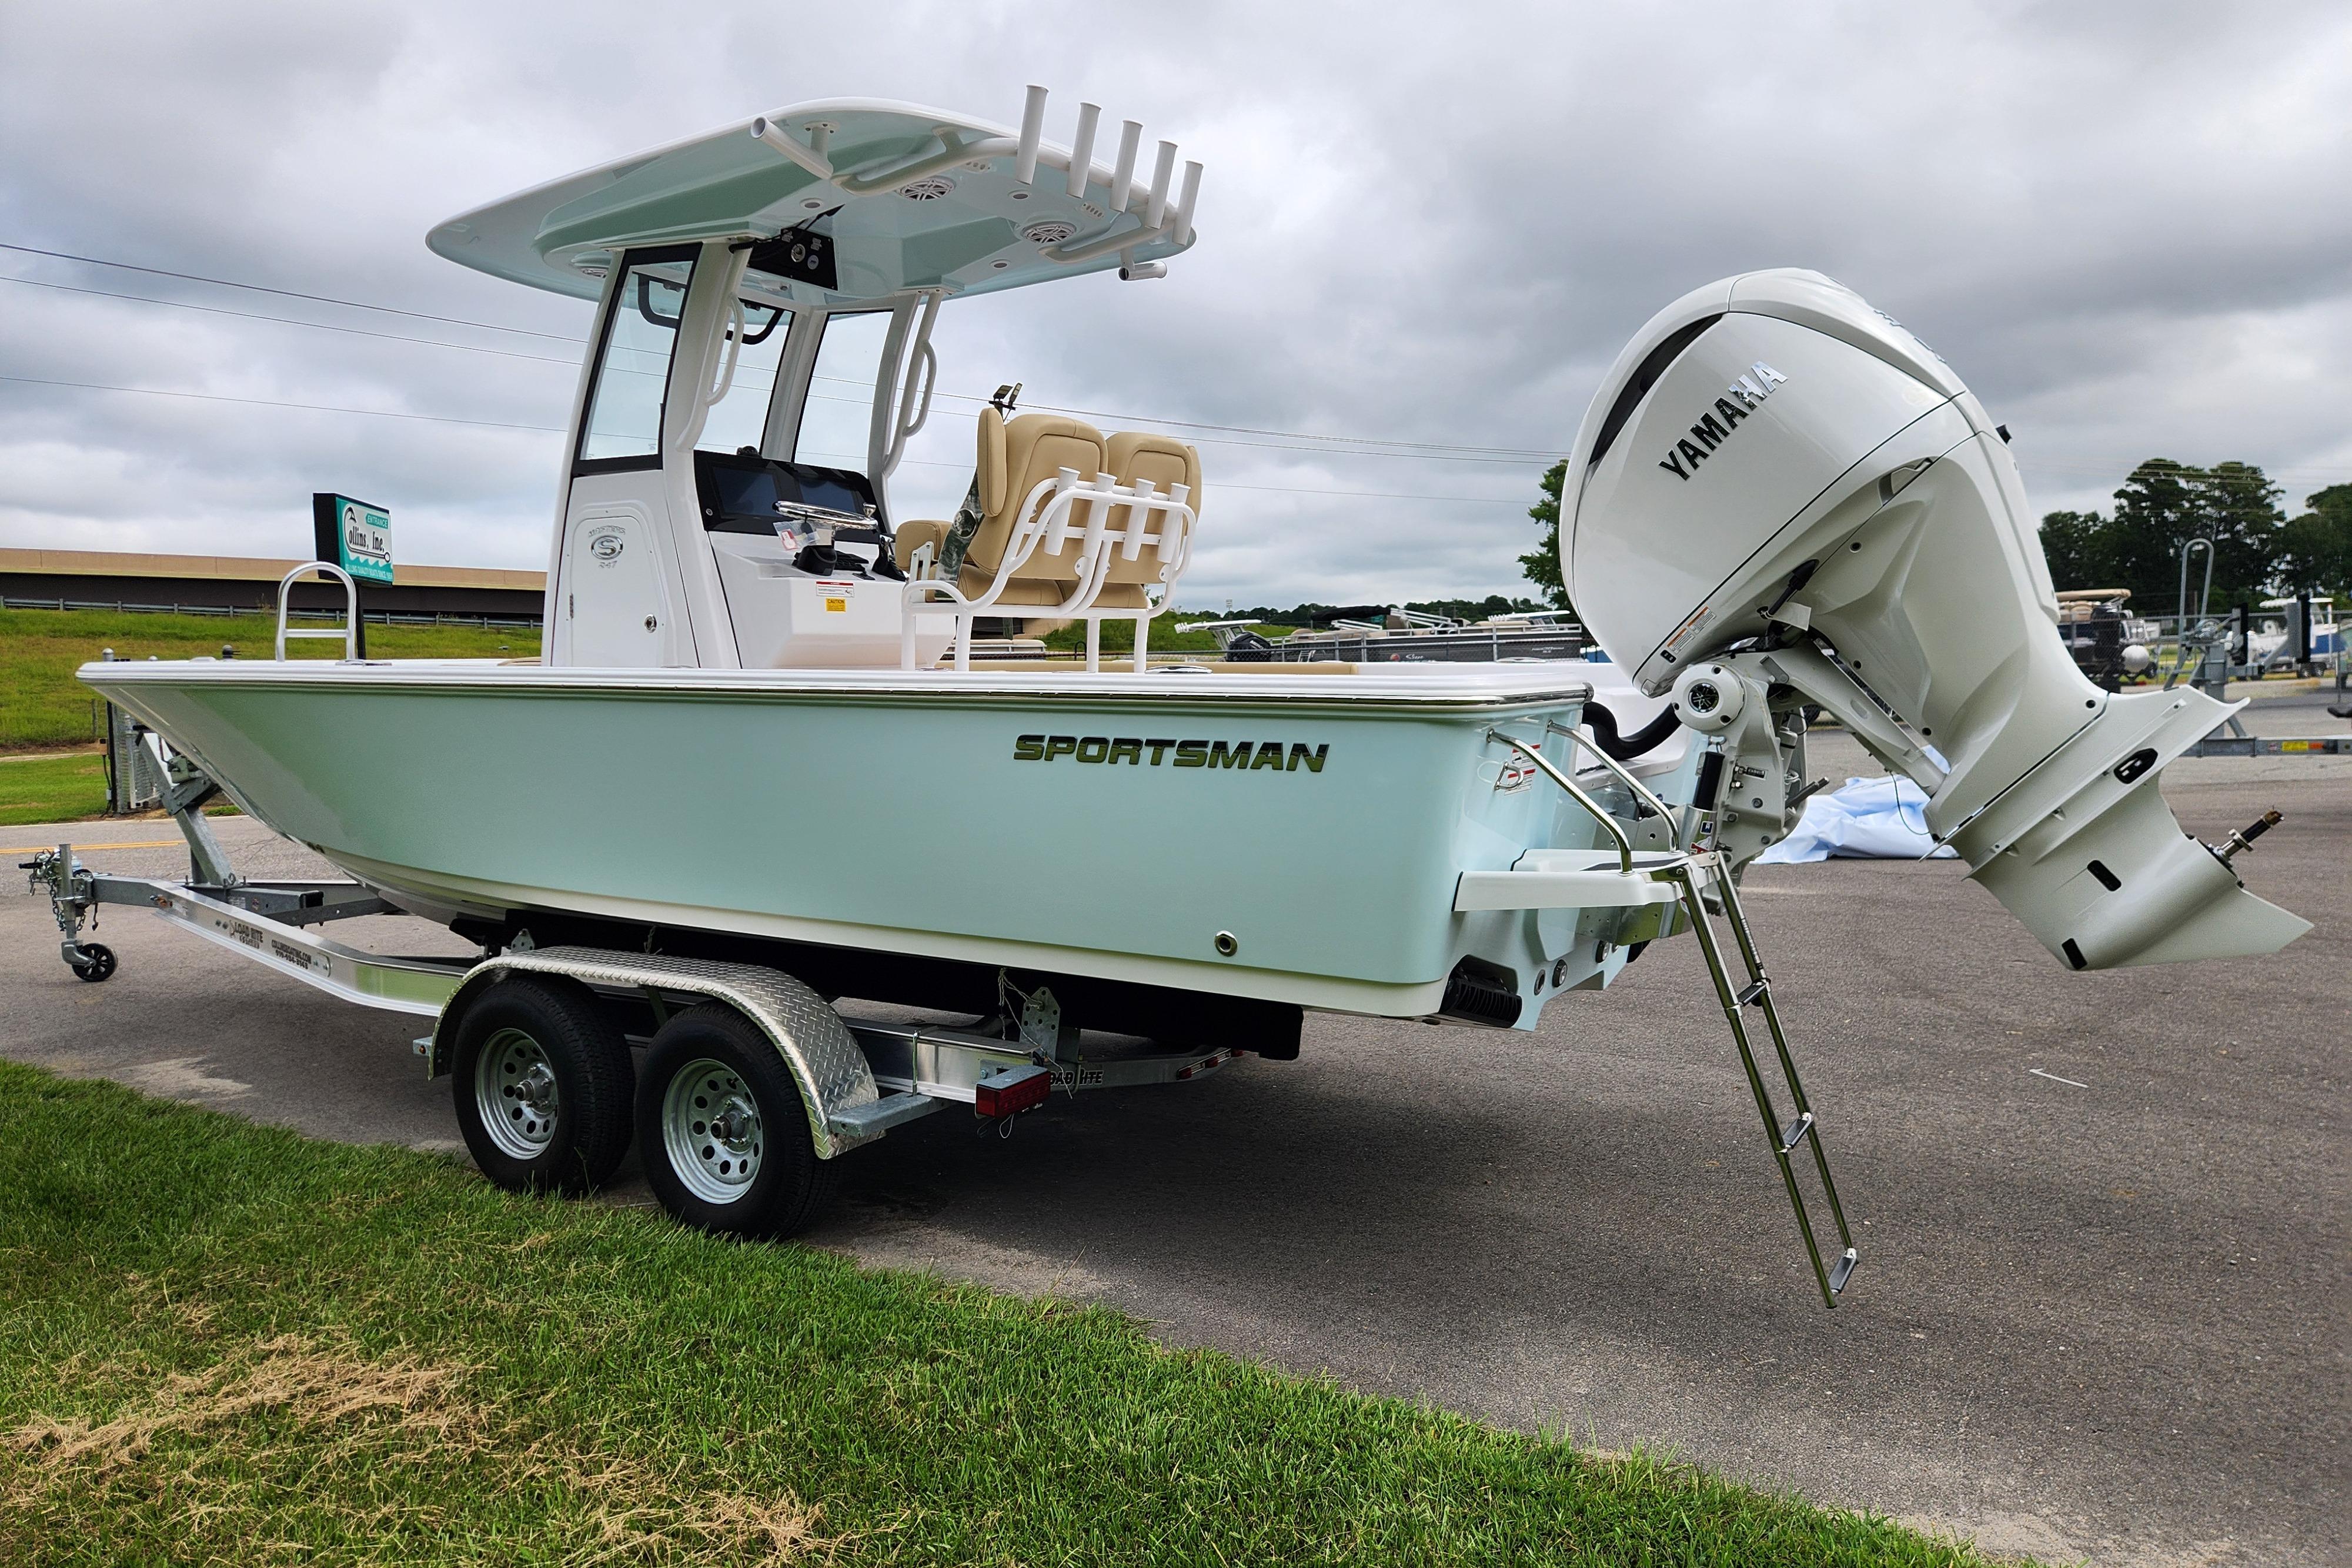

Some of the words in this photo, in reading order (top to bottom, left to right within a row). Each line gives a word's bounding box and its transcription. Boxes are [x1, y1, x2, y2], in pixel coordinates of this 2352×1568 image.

[1658, 360, 1788, 481] YAMAHA
[367, 514, 387, 528] ENTRANCE
[1013, 734, 1330, 773] SPORTSMAN
[1050, 1071, 1075, 1085] OAD
